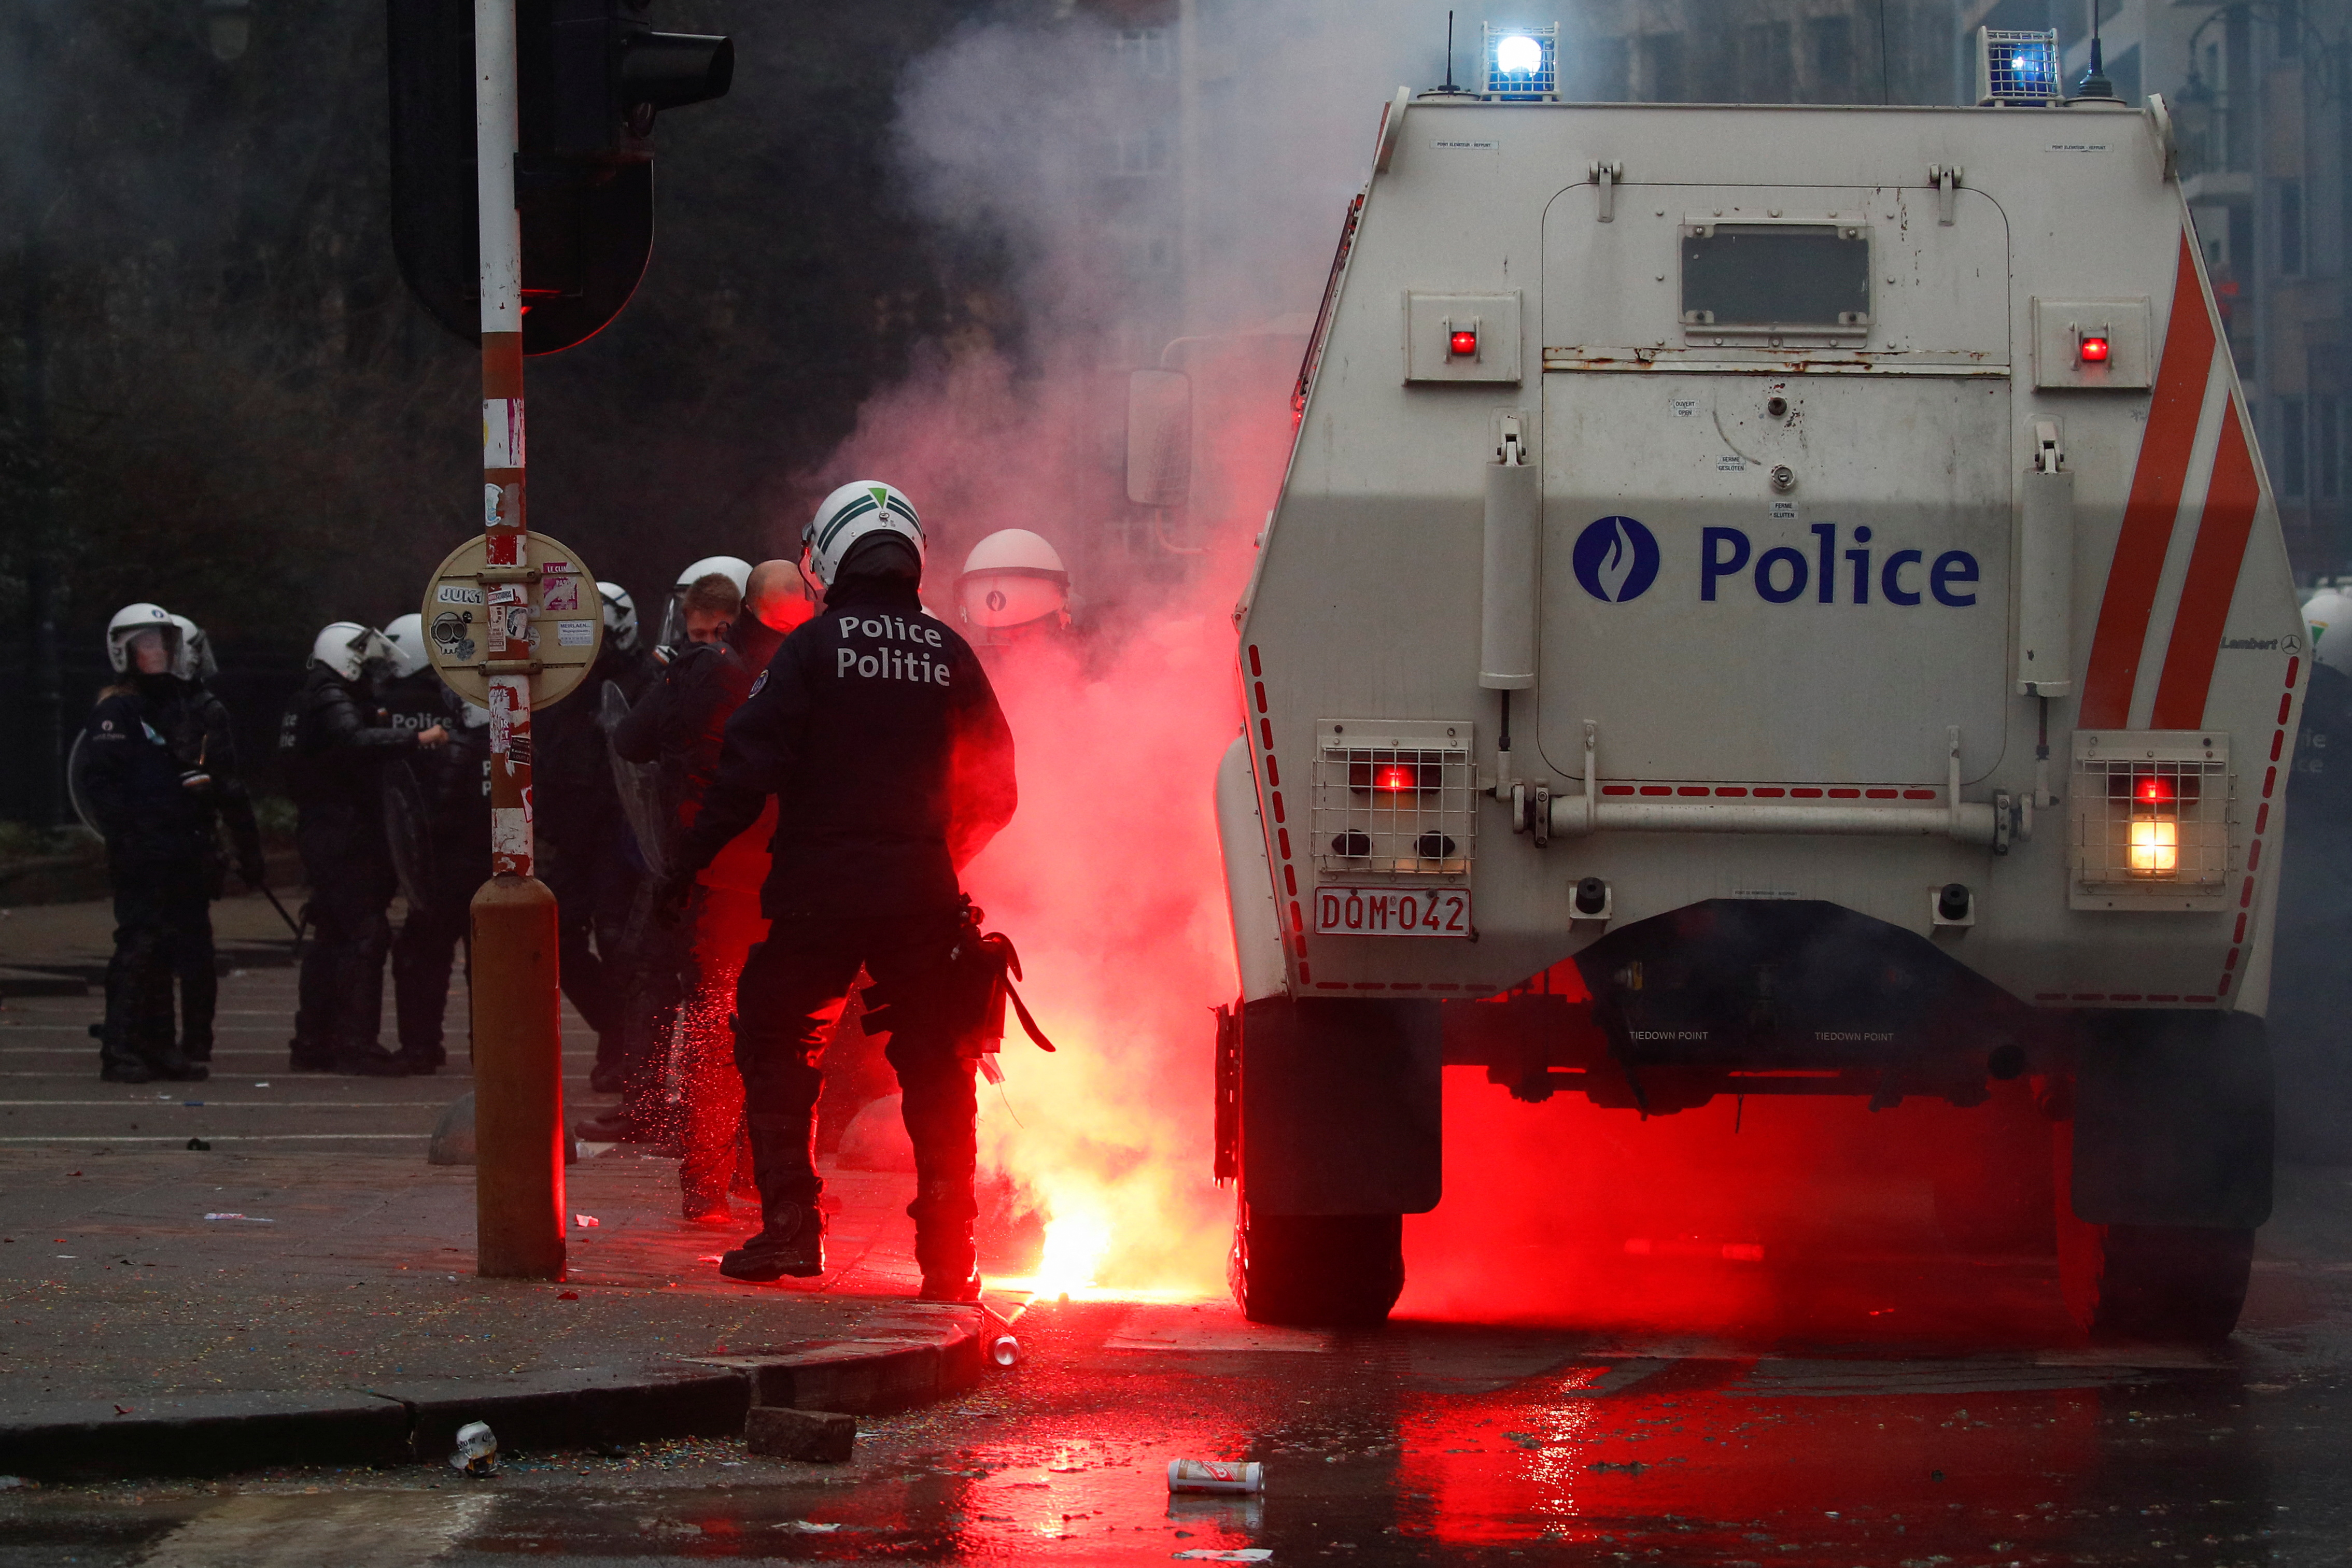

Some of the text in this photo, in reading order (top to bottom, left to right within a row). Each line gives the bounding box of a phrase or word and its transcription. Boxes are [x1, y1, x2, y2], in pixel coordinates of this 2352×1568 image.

[1701, 523, 1979, 606] Police
[838, 614, 942, 647] Police
[837, 647, 950, 687] Politie
[1629, 1031, 1708, 1040] TIEDOWN POINT
[1815, 1032, 1894, 1041] TIEDOWN POINT
